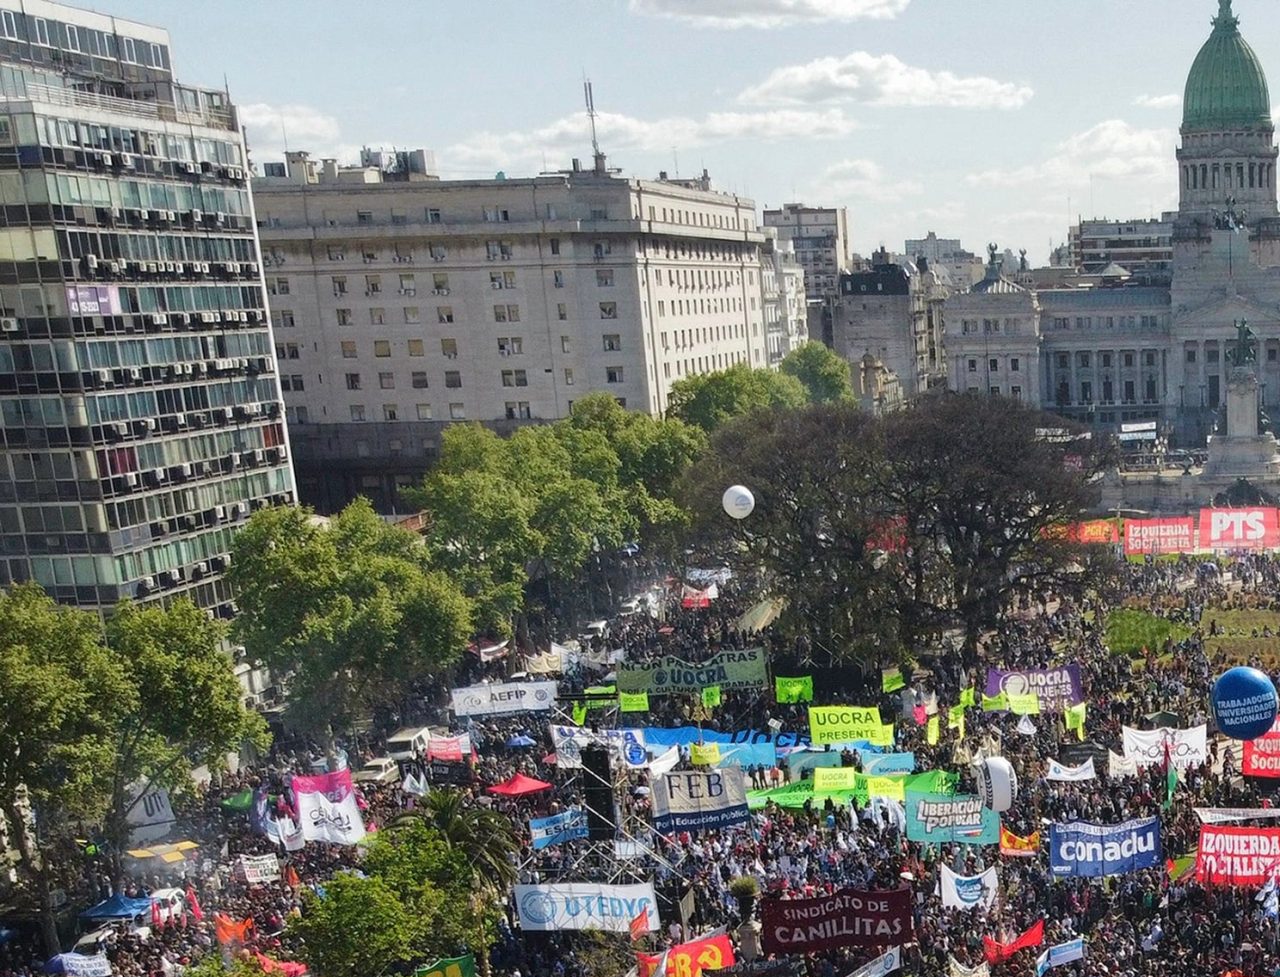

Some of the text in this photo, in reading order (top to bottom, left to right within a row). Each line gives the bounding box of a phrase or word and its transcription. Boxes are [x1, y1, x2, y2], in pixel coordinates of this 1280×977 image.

[1129, 524, 1189, 536] IZQUIERDA
[1210, 511, 1265, 540] PTS
[670, 666, 728, 687] UOCRA
[1029, 670, 1071, 685] UOCRA
[489, 689, 527, 702] AEFIP
[1217, 691, 1274, 709] TRABAJADORES
[815, 712, 875, 726] UOCRA
[1217, 701, 1276, 717] UNIVERSIDADES
[1224, 710, 1273, 726] NACIONALES
[819, 729, 877, 740] PRESENTE
[666, 773, 724, 799] FEB
[676, 812, 719, 827] Educación
[720, 808, 748, 822] Pública
[918, 797, 983, 820] LIBERACIÓN
[924, 813, 981, 834] POPULAR
[1060, 831, 1154, 862] conadu
[1202, 832, 1280, 855] IZQUIERDA
[564, 896, 654, 918] UTEDYC
[783, 895, 889, 921] SINDICATO DE
[775, 916, 902, 944] CANILLITAS
